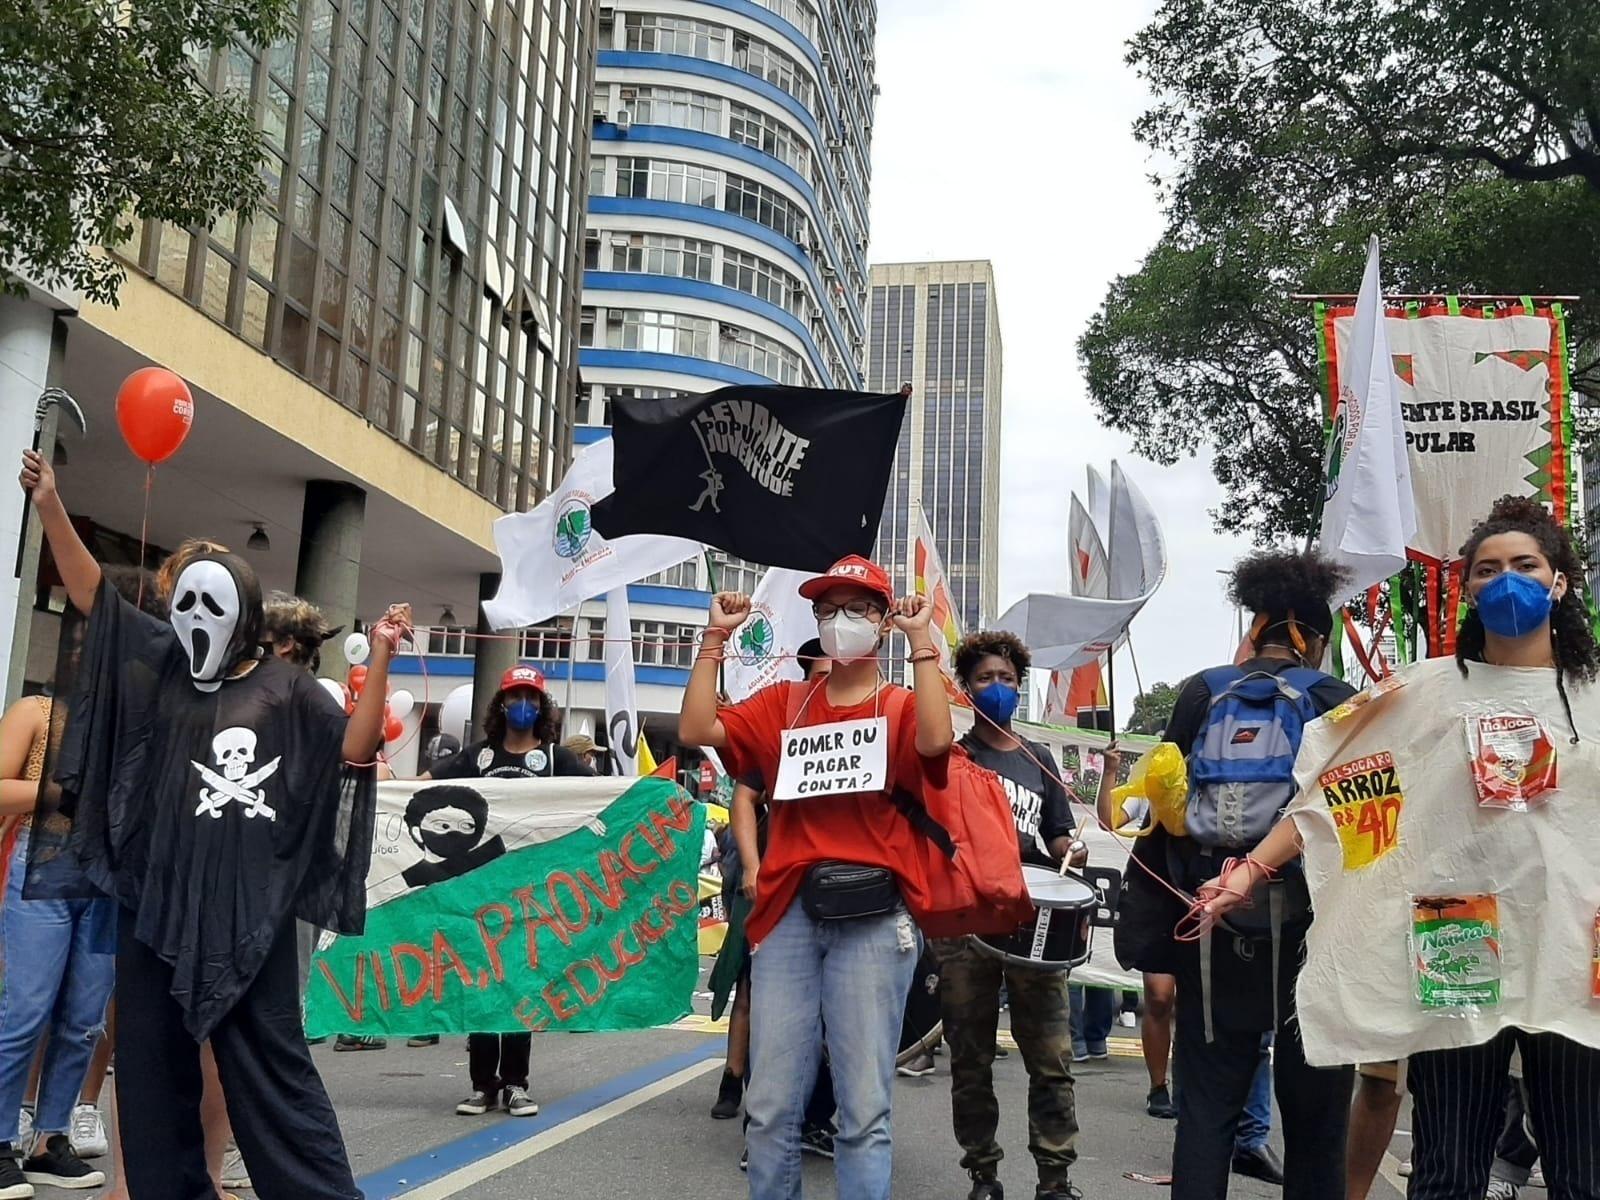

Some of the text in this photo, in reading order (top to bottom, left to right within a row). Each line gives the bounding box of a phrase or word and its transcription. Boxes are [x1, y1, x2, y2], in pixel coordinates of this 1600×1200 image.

[1400, 401, 1540, 422] ENTE BRASIL
[697, 400, 810, 470] LEVANTE
[702, 420, 795, 481] POPULAR DA
[1405, 432, 1476, 452] PULAR
[707, 433, 794, 497] JUVENTUDE
[829, 564, 866, 577] CUT
[787, 727, 877, 758] COMER OU
[803, 755, 862, 776] PAGAR
[1323, 766, 1401, 807] ARROZ
[375, 812, 403, 842] TO
[1356, 797, 1401, 856] 40
